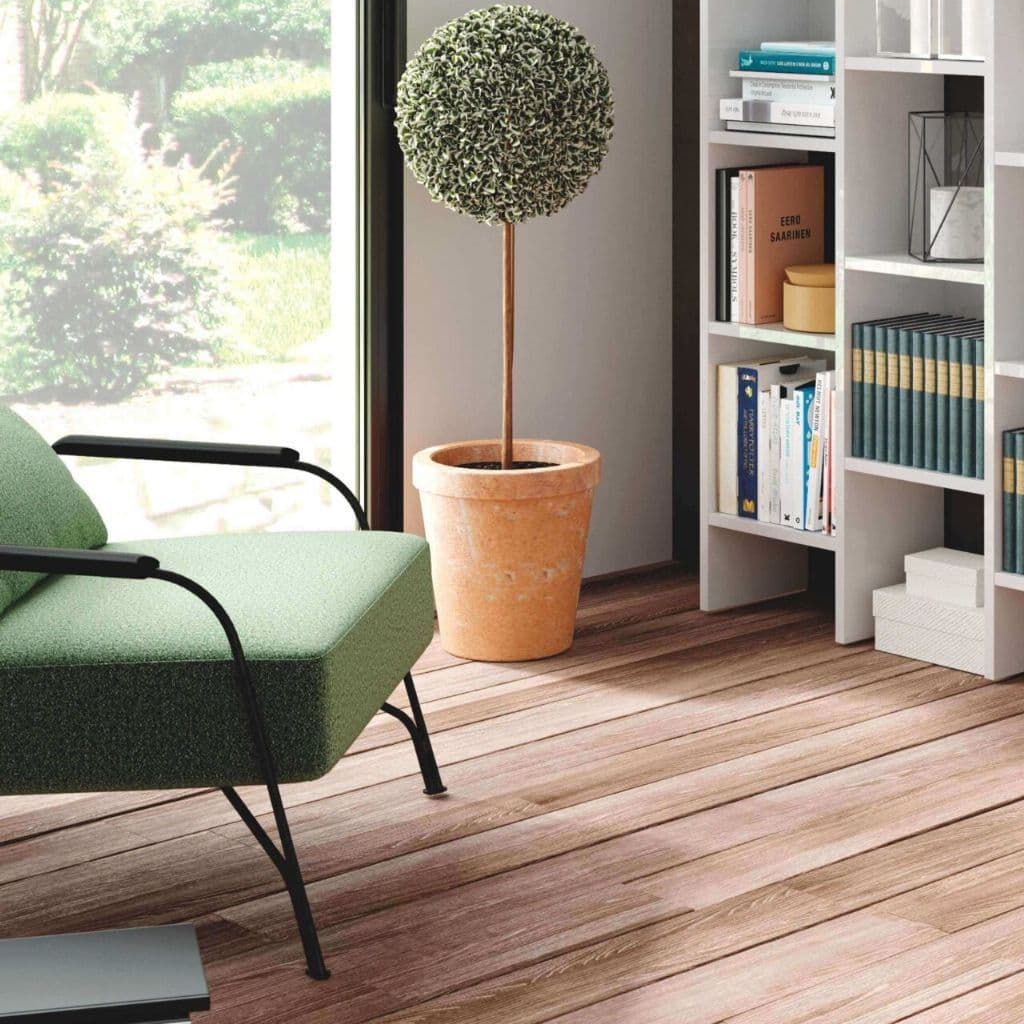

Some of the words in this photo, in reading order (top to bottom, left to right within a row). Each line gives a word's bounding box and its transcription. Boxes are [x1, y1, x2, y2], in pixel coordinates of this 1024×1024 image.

[780, 215, 801, 227] EERO
[770, 228, 812, 242] SAARINEN
[813, 404, 822, 430] NEWTON
